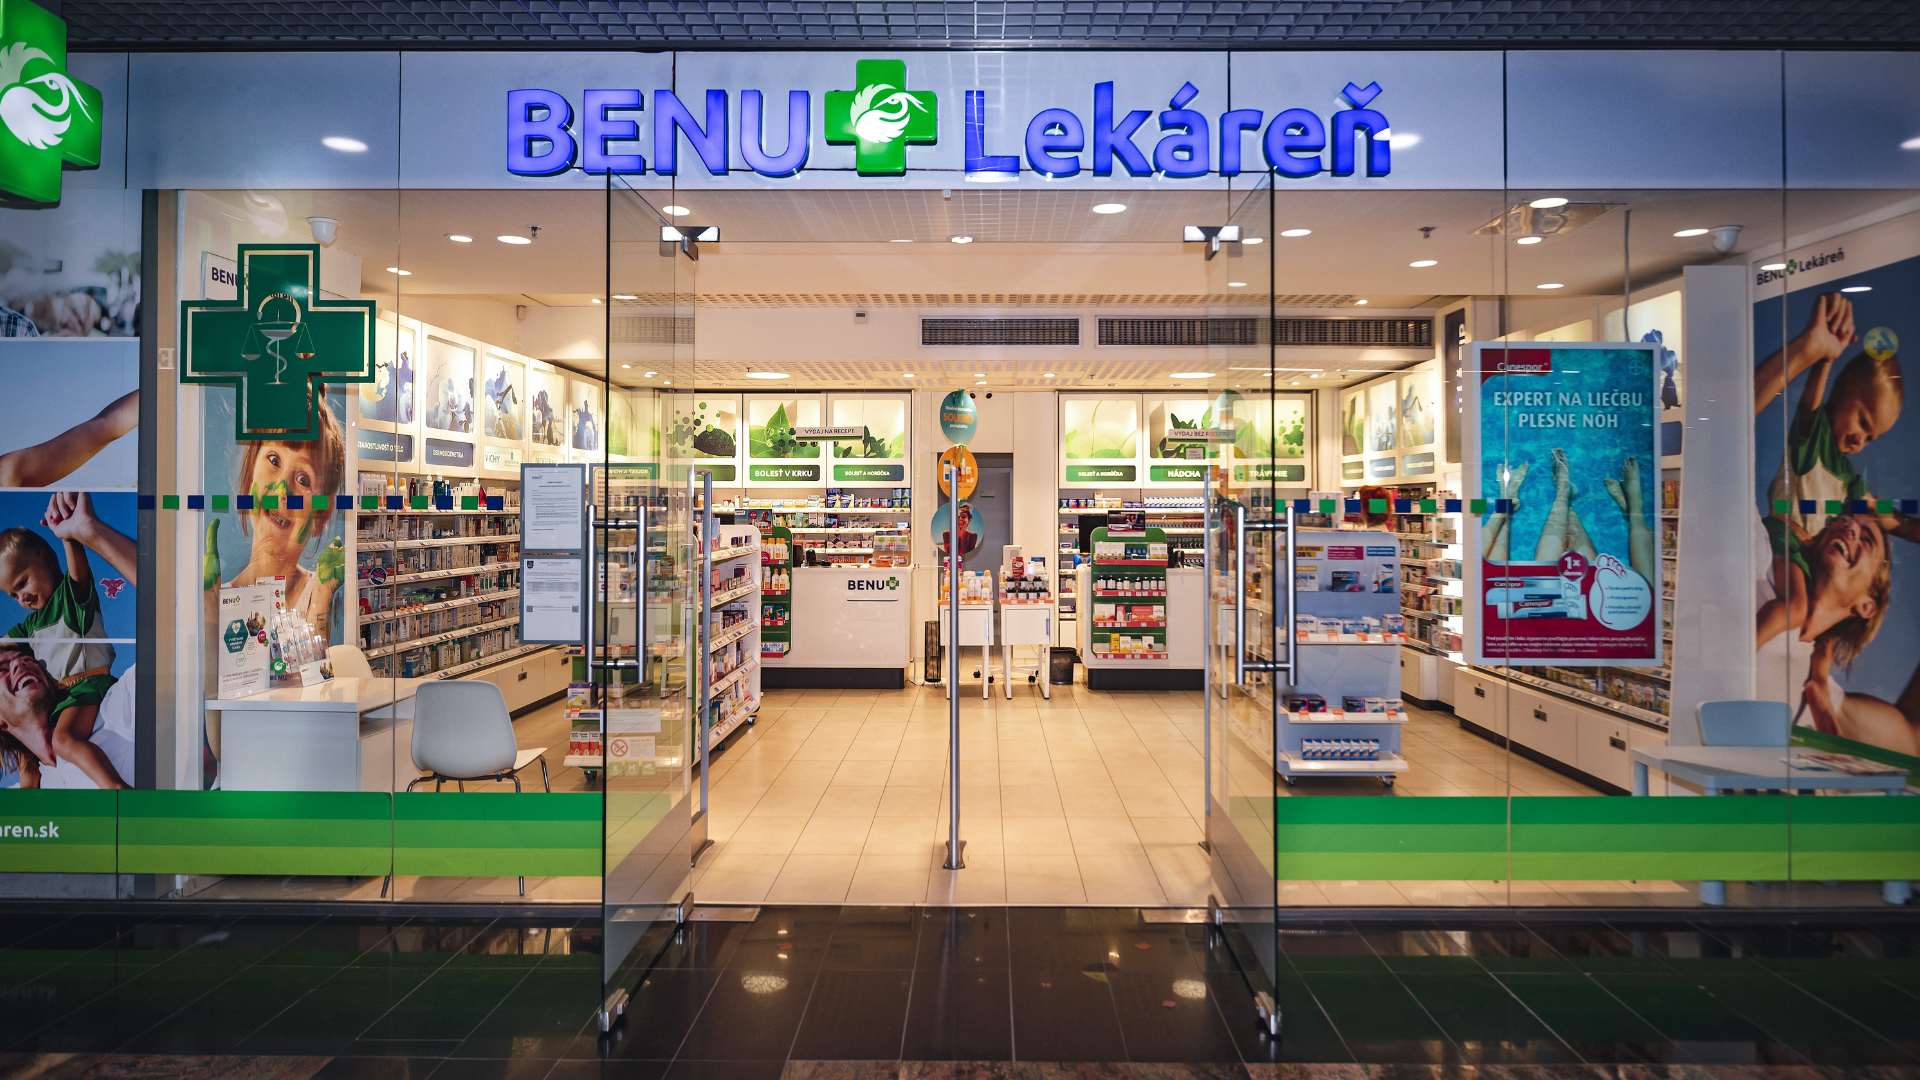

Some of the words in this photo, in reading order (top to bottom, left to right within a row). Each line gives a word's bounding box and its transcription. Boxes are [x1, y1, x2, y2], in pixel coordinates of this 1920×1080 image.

[506, 87, 809, 177] BENU
[965, 81, 1393, 178] Lekáreň
[1799, 247, 1845, 272] Lekáreň
[1493, 391, 1553, 407] EXPERT
[1558, 392, 1582, 406] NA
[1587, 388, 1643, 407] LIEČBU
[943, 412, 974, 425] SOLERO
[1518, 413, 1577, 428] PLESNE
[1582, 410, 1618, 428] NÔH
[484, 454, 501, 463] VICHY
[755, 468, 783, 477] BOLESŤ
[1168, 469, 1201, 478] NÁDCHA
[848, 580, 885, 590] BENU
